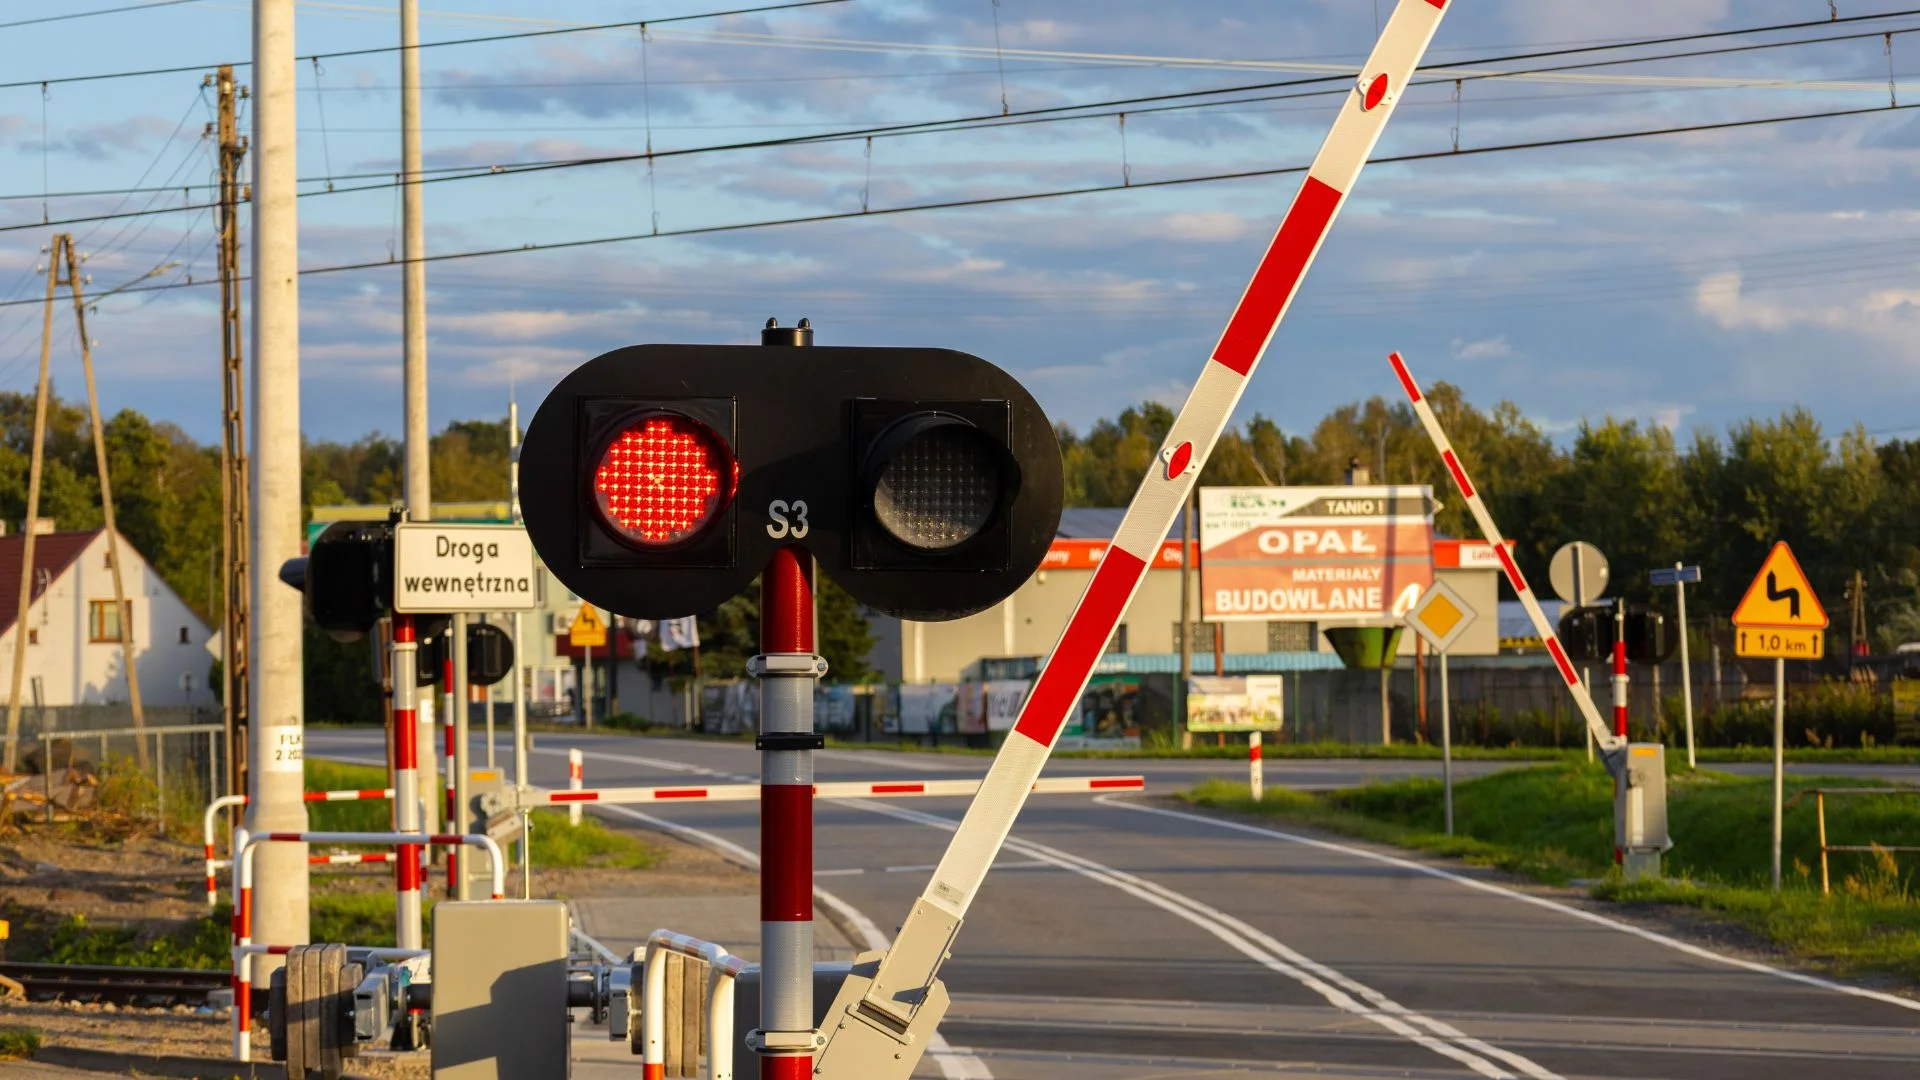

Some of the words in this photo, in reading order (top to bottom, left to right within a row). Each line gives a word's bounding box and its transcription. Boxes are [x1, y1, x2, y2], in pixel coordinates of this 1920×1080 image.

[766, 499, 809, 539] S3
[1326, 500, 1374, 514] TANIO
[436, 535, 499, 564] Droga
[1257, 530, 1377, 554] OPAŁ
[404, 571, 529, 599] wewnętrzna
[1292, 567, 1383, 583] MATERIAŁY
[1215, 587, 1384, 612] BUDOWLANE
[1759, 634, 1781, 651] 1,0
[1785, 639, 1807, 651] km
